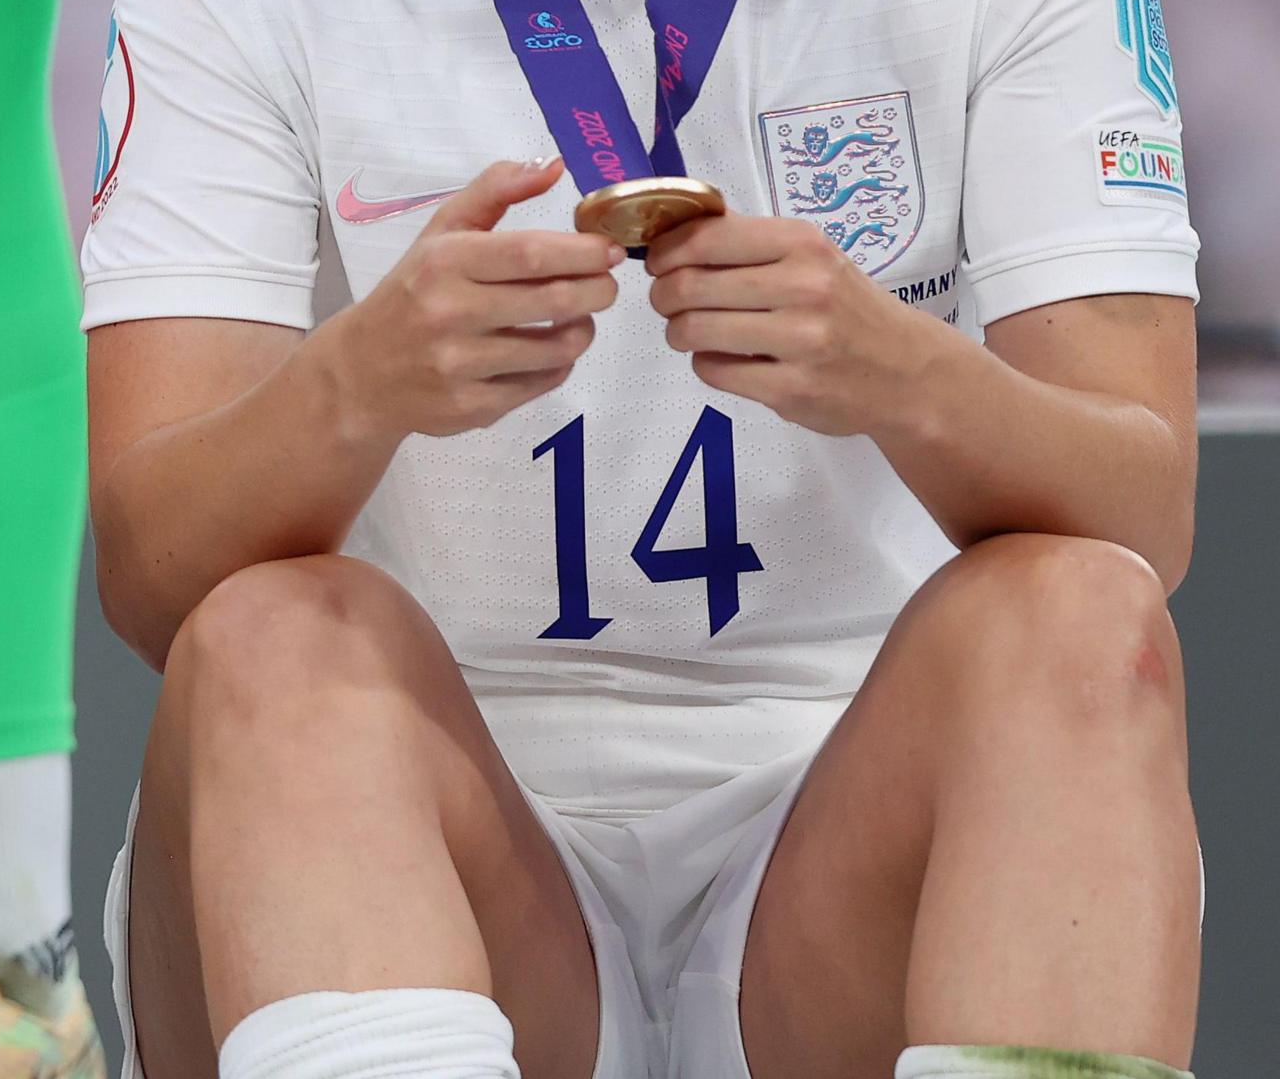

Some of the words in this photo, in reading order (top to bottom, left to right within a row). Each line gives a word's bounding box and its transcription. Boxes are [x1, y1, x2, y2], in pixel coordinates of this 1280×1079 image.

[1099, 130, 1140, 147] UEFA
[889, 264, 958, 305] RMANY
[532, 404, 765, 640] 14
